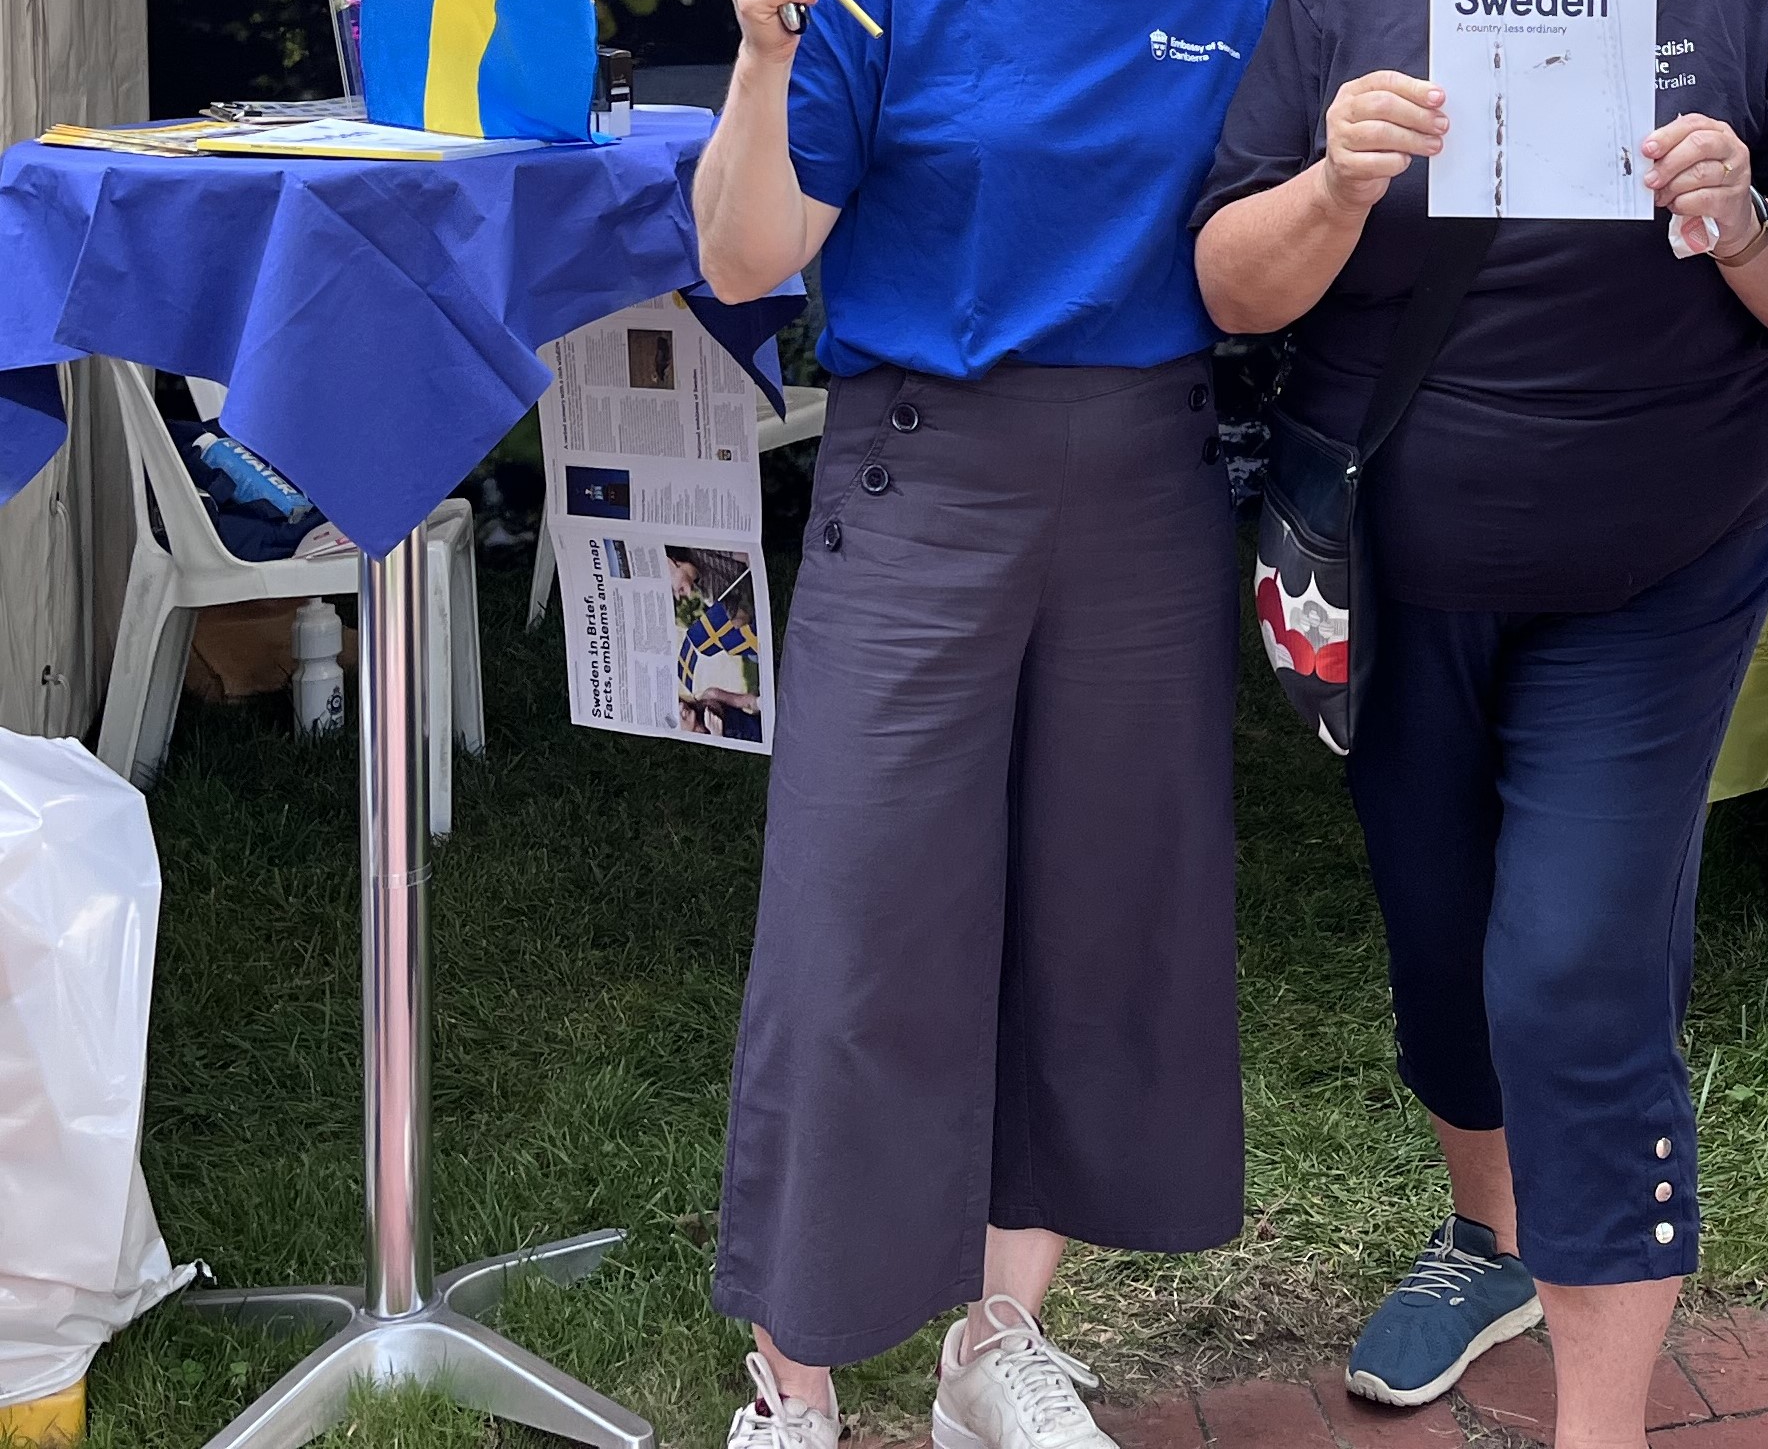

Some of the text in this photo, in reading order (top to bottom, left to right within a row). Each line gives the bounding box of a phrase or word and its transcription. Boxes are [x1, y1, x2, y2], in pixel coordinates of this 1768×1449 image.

[1456, 23, 1567, 36] A country less ordinary
[1205, 41, 1216, 51] of
[1655, 38, 1694, 56] edish
[1169, 48, 1209, 62] Canberra
[1655, 58, 1670, 73] le
[589, 539, 614, 720] Facts, emblems and map
[588, 640, 598, 657] in
[588, 660, 602, 718] Sweden
